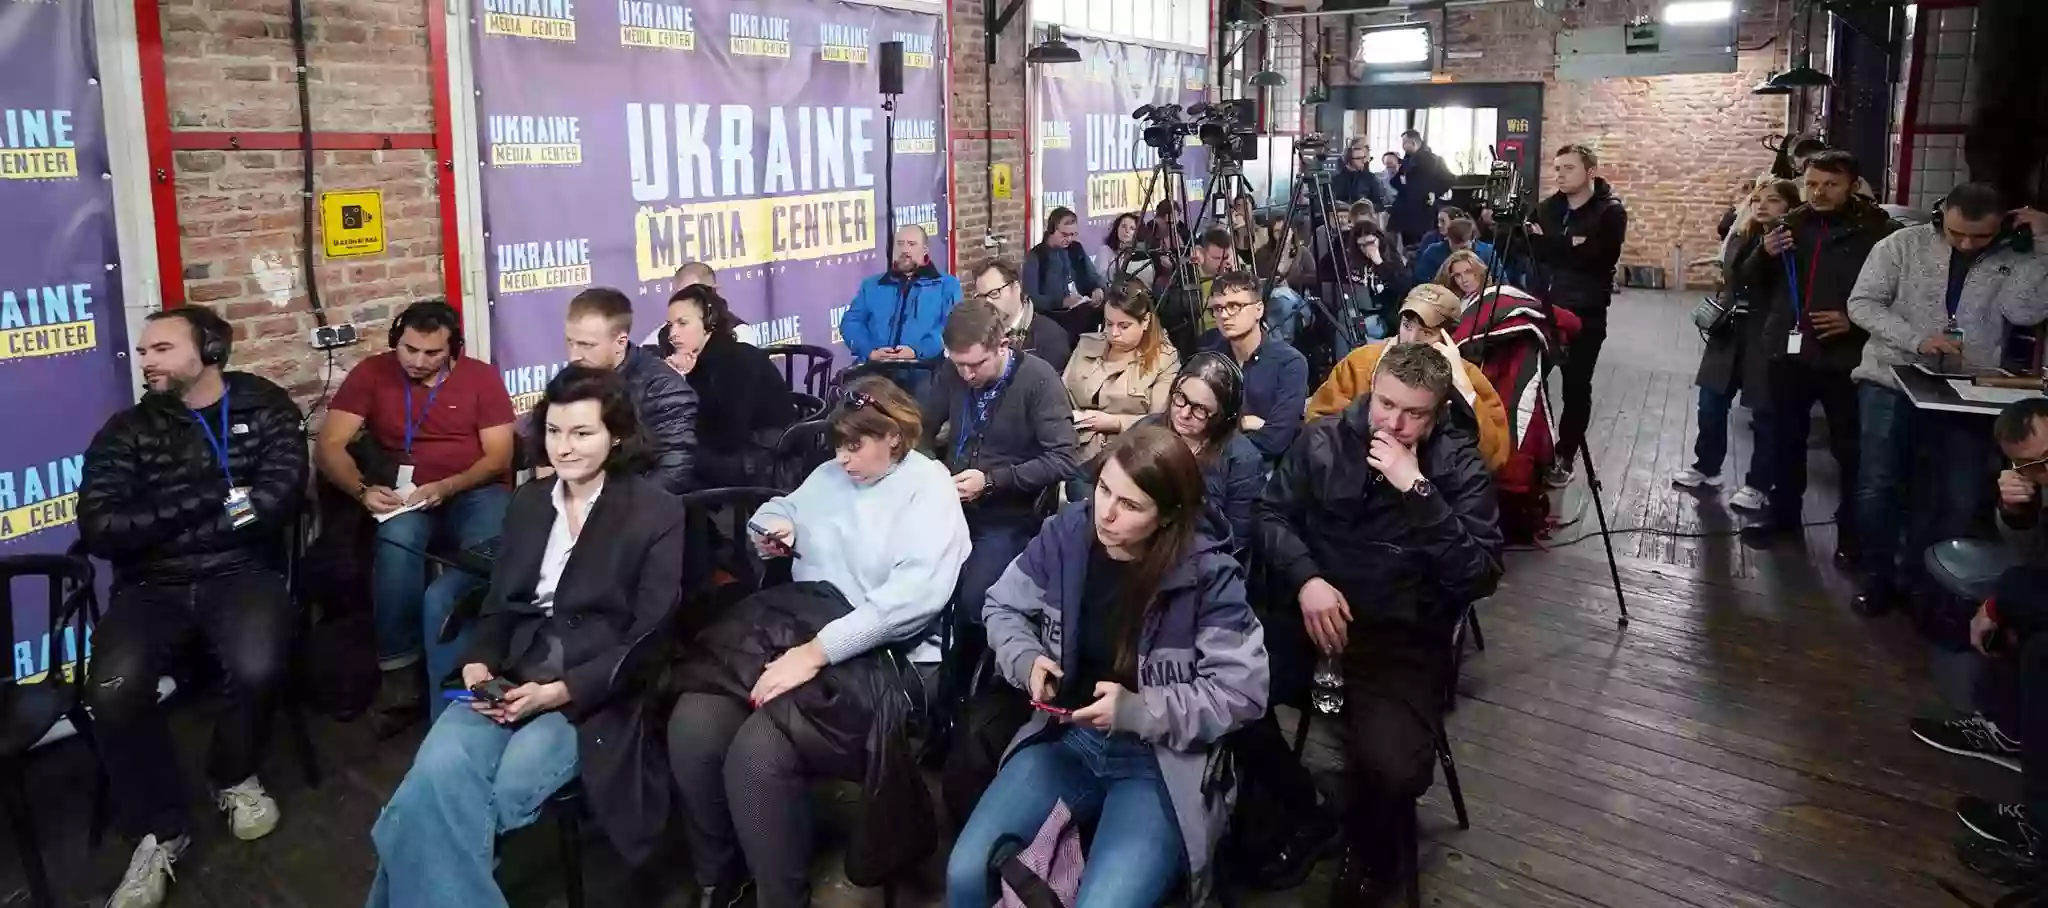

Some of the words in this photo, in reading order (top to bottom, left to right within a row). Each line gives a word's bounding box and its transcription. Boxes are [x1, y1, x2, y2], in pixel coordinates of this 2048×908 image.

[531, 20, 572, 37] CENTER
[619, 0, 694, 31] UKRAINE
[730, 12, 789, 41] UKRAINE
[0, 109, 75, 148] INE
[489, 115, 580, 143] UKRAINE
[495, 146, 533, 162] MEDIA
[626, 102, 875, 201] UKRAINE
[1092, 179, 1128, 210] MEDIA
[648, 211, 747, 269] MEDIA
[772, 199, 868, 253] CENTER
[498, 239, 590, 272] UKRAINE
[503, 273, 539, 289] MEDIA
[545, 267, 588, 285] CENTER
[1, 284, 94, 329] AINE
[9, 325, 89, 354] CENTER
